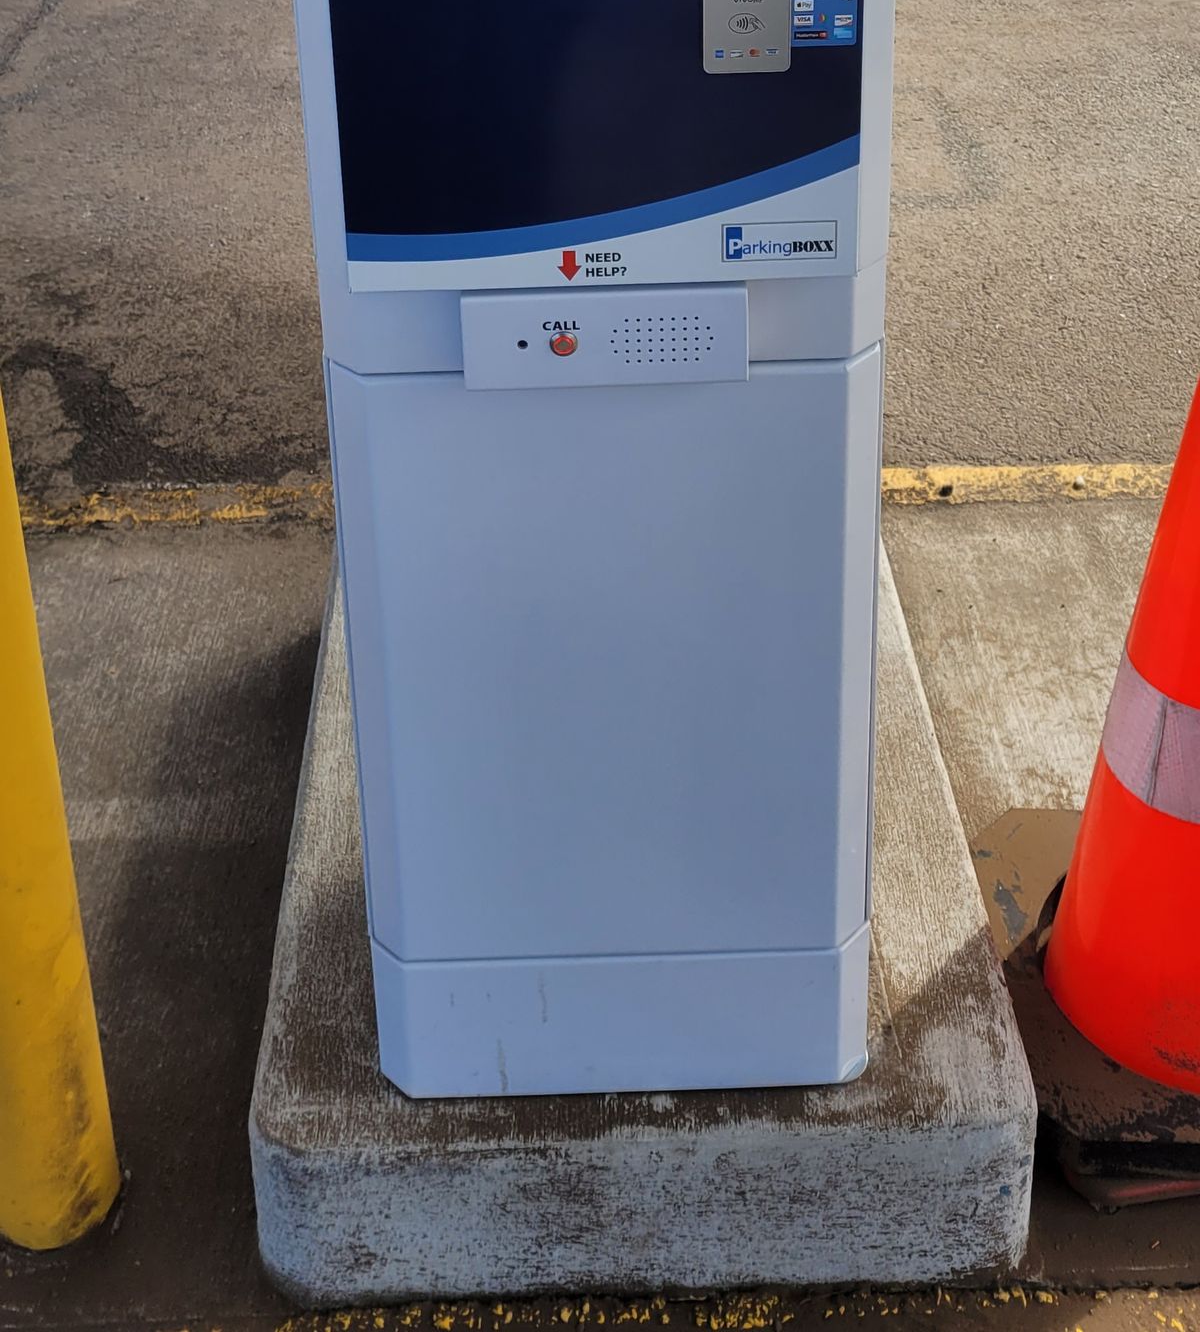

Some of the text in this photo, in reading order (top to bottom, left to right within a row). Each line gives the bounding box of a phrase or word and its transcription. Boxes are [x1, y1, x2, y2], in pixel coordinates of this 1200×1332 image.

[728, 239, 834, 257] ParkingBOXX
[585, 252, 621, 263] NEED
[585, 266, 627, 278] HELP?
[542, 320, 581, 331] CALL
